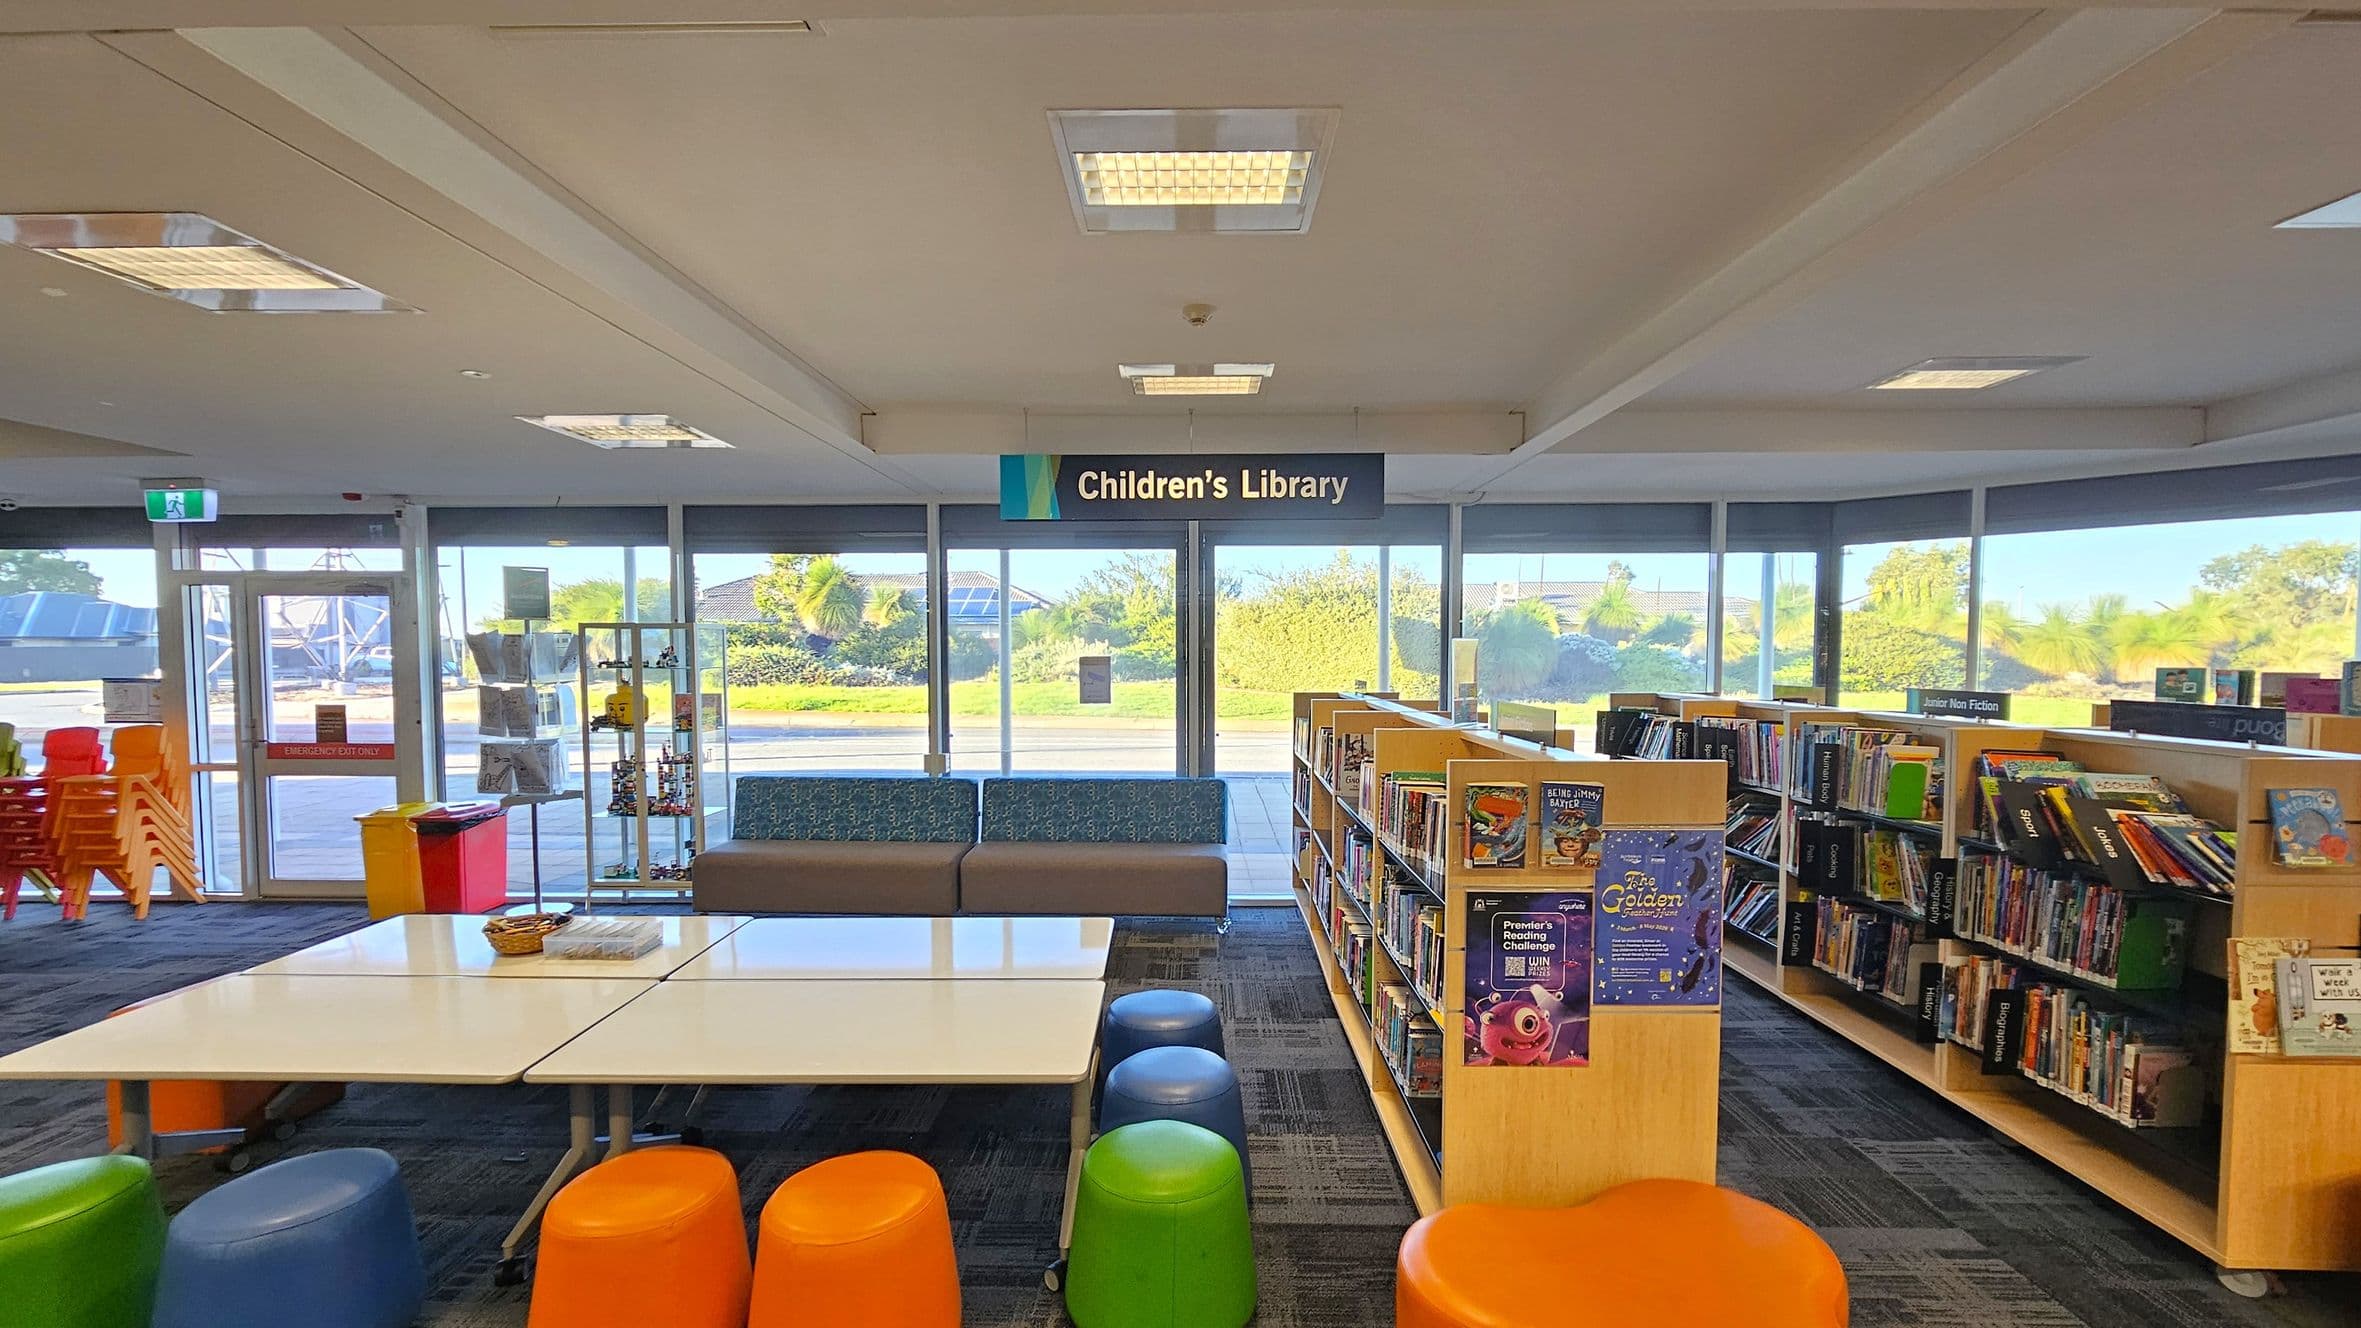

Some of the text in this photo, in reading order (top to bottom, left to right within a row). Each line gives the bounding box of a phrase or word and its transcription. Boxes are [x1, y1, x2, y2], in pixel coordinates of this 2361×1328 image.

[1078, 469, 1348, 504] Children's Library
[1923, 697, 1999, 711] Junior Non Fiction
[284, 746, 380, 756] EMERGENCY EXIT ONLY
[1820, 751, 1832, 804] Human Body
[1547, 788, 1571, 799] BEING
[1549, 798, 1580, 809] BAXTER
[2020, 808, 2040, 838] Sport
[2093, 825, 2119, 859] Jokes
[1828, 843, 1839, 879] Cooking
[1624, 870, 1658, 892] The
[1942, 876, 1955, 910] History
[1601, 884, 1684, 913] Golden
[1929, 871, 1944, 925] Geography
[1503, 920, 1553, 930] Premier's
[1503, 931, 1547, 942] Reading
[1503, 941, 1556, 952] Challenge
[1791, 933, 1801, 957] Crafts
[1528, 956, 1550, 967] WIN
[1922, 986, 1935, 1020] History
[1994, 1002, 2011, 1063] Biographies
